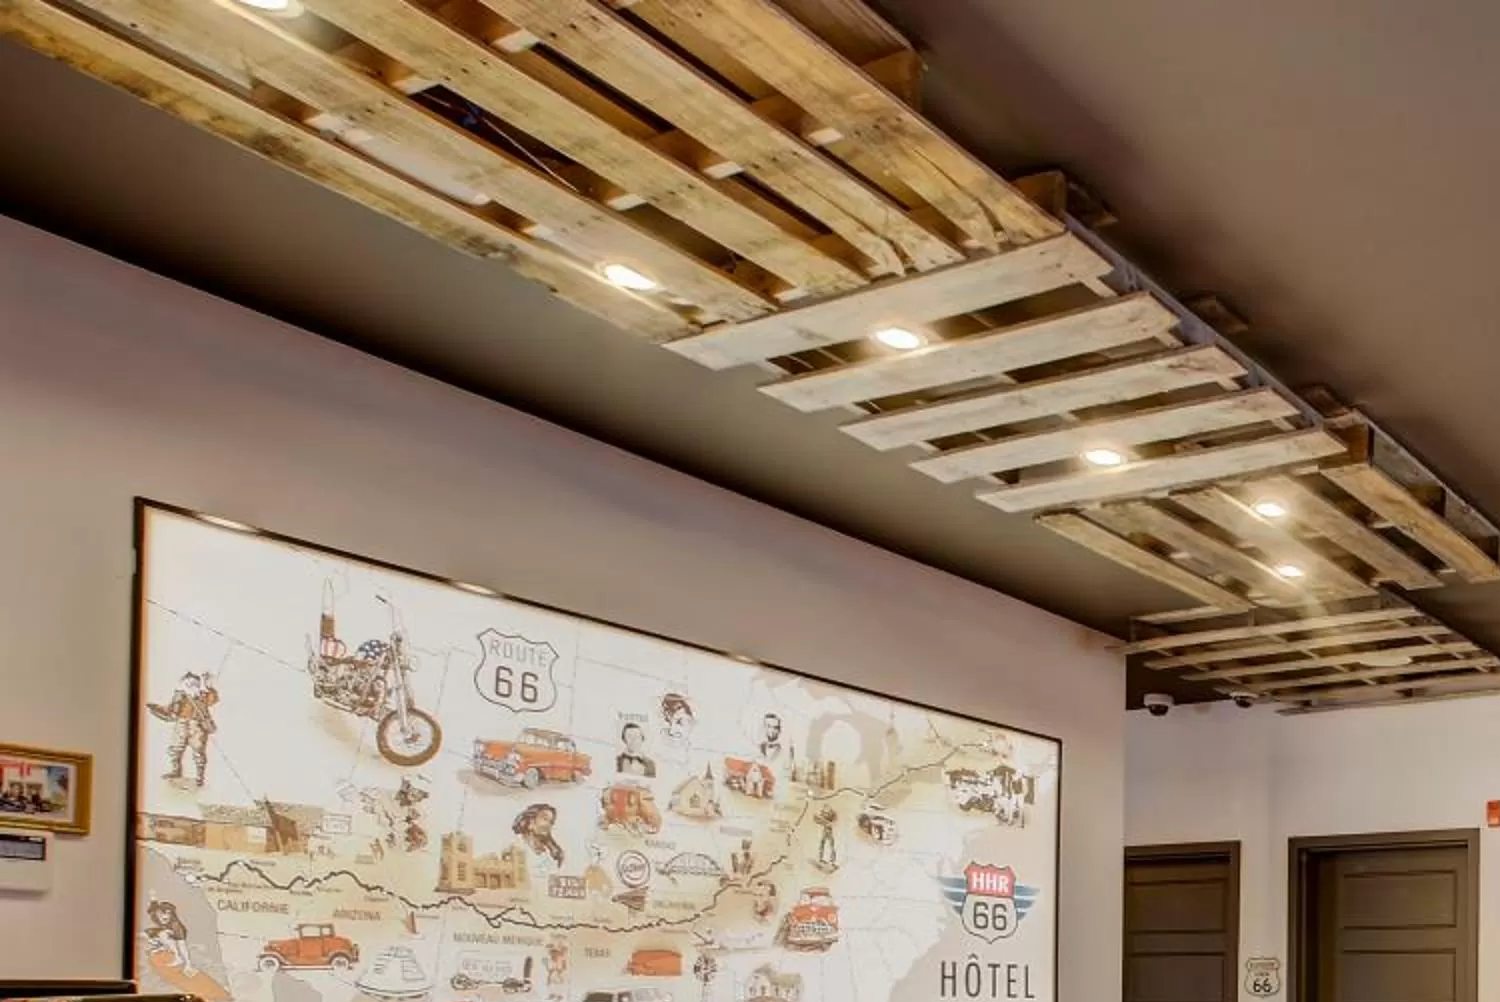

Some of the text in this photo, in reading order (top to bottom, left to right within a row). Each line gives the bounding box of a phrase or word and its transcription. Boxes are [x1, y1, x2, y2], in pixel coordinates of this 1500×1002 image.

[488, 640, 550, 668] ROUTE
[495, 665, 539, 703] 66
[971, 871, 1010, 894] HHR
[217, 899, 289, 914] CALIFORNIE
[972, 901, 1008, 932] 66
[940, 953, 1036, 999] HÔTEL
[1253, 978, 1272, 993] 66
